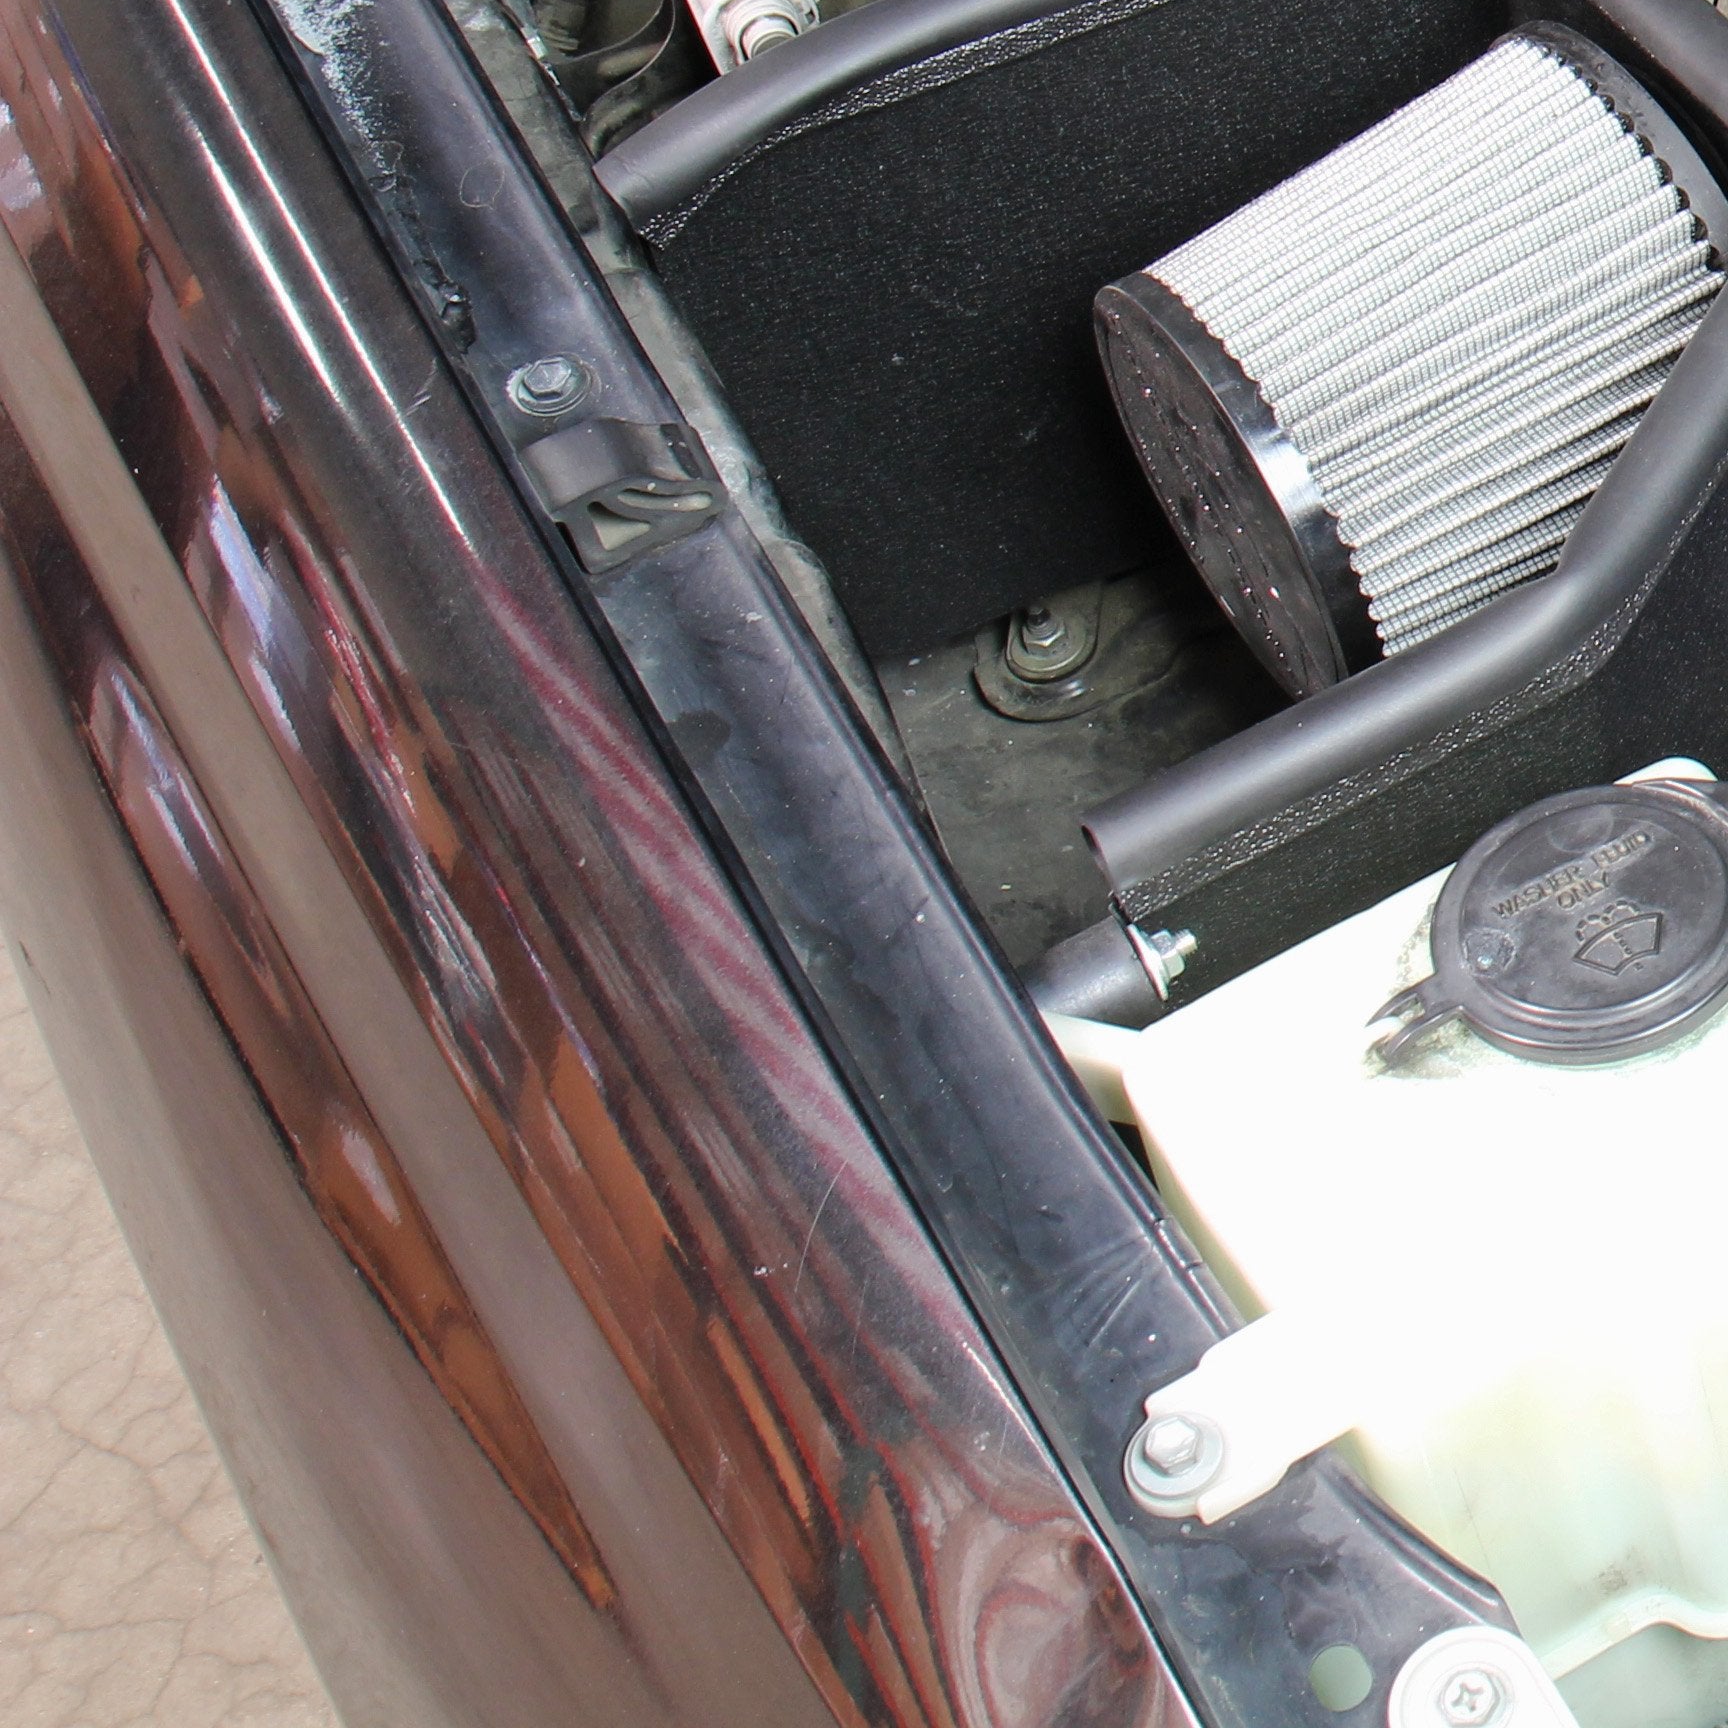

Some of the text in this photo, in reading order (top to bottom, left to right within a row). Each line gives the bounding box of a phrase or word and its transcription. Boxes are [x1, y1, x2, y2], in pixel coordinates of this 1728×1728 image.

[1493, 829, 1653, 920] WASHER FLUID
[1555, 870, 1610, 910] ONLY
